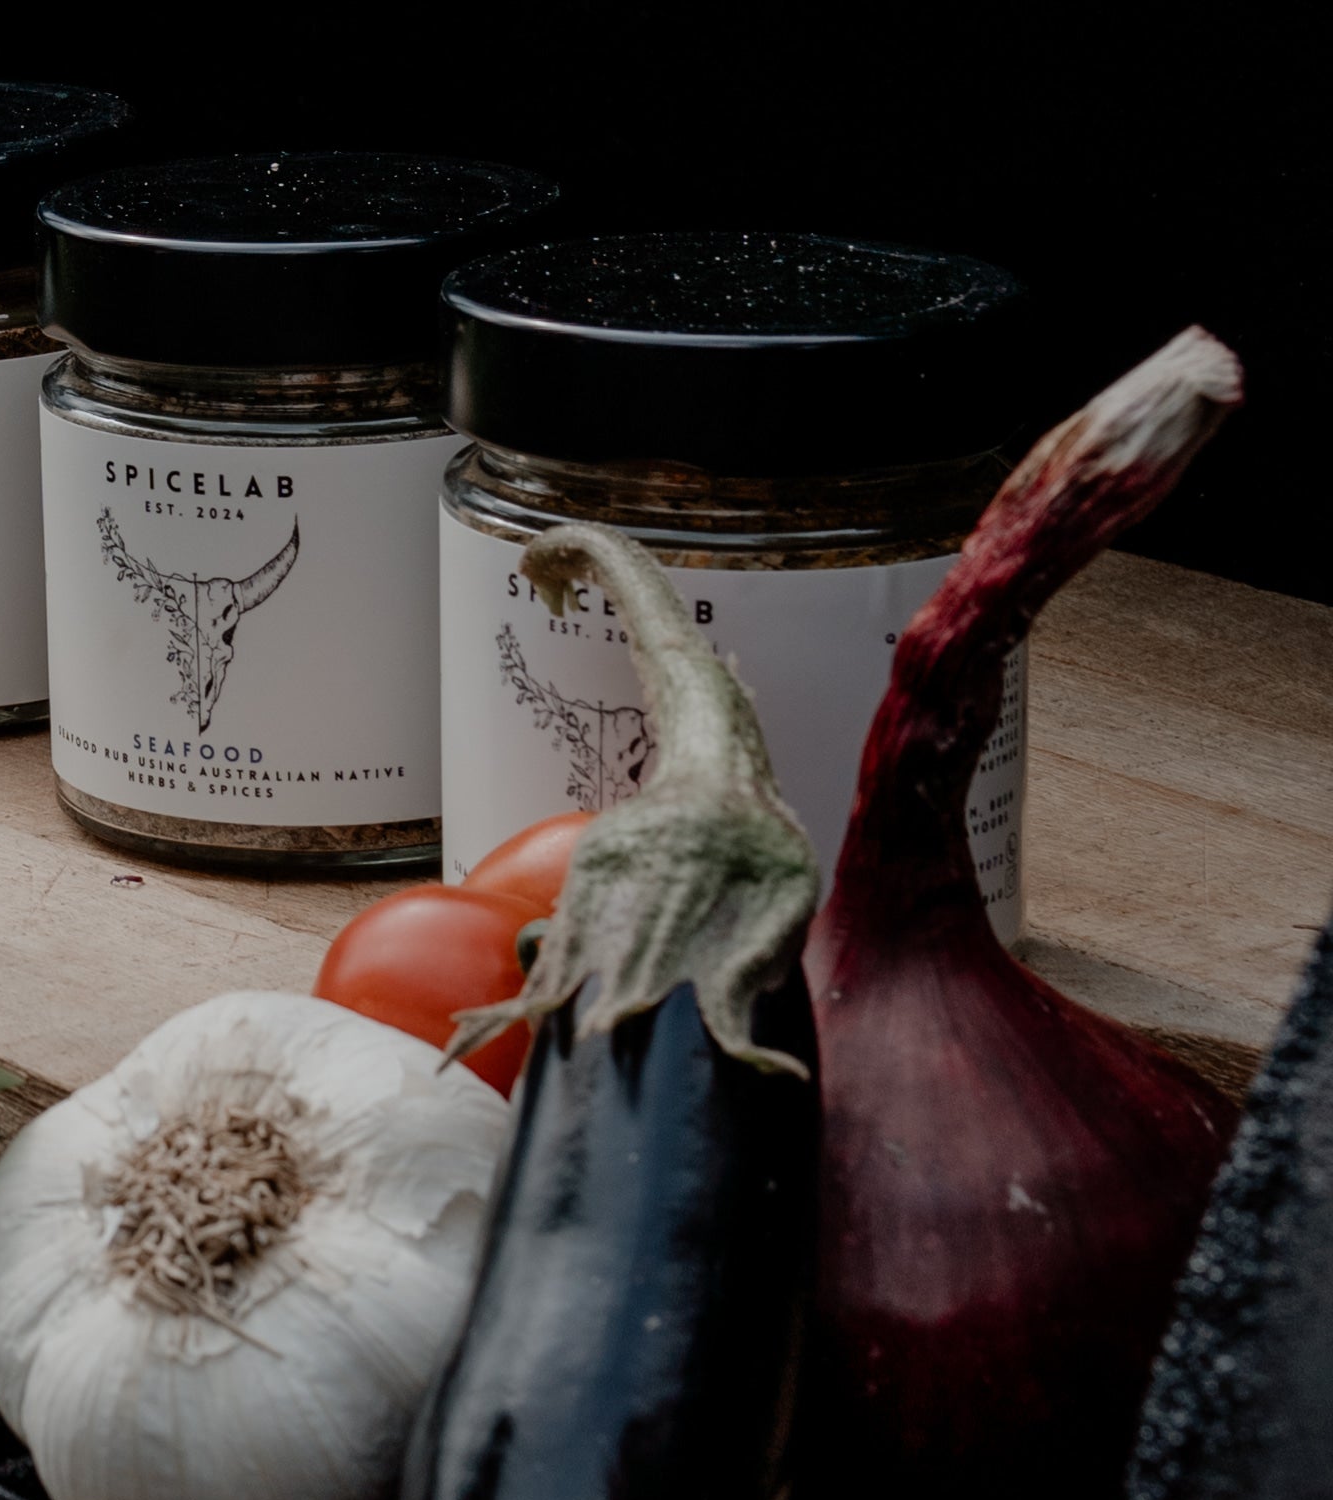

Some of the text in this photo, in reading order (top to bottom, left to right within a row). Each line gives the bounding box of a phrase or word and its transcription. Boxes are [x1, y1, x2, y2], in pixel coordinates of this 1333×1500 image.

[105, 460, 295, 499] SPICELAB
[144, 500, 245, 521] EST. 2024
[549, 618, 591, 639] EST.
[132, 733, 263, 764] SEAFOOD
[103, 746, 129, 764] RUB
[137, 755, 187, 774] USING
[199, 765, 321, 782] AUSTRALIAN
[334, 765, 406, 781] NATIVE
[127, 770, 176, 789] HERBS
[208, 783, 274, 798] SPICES
